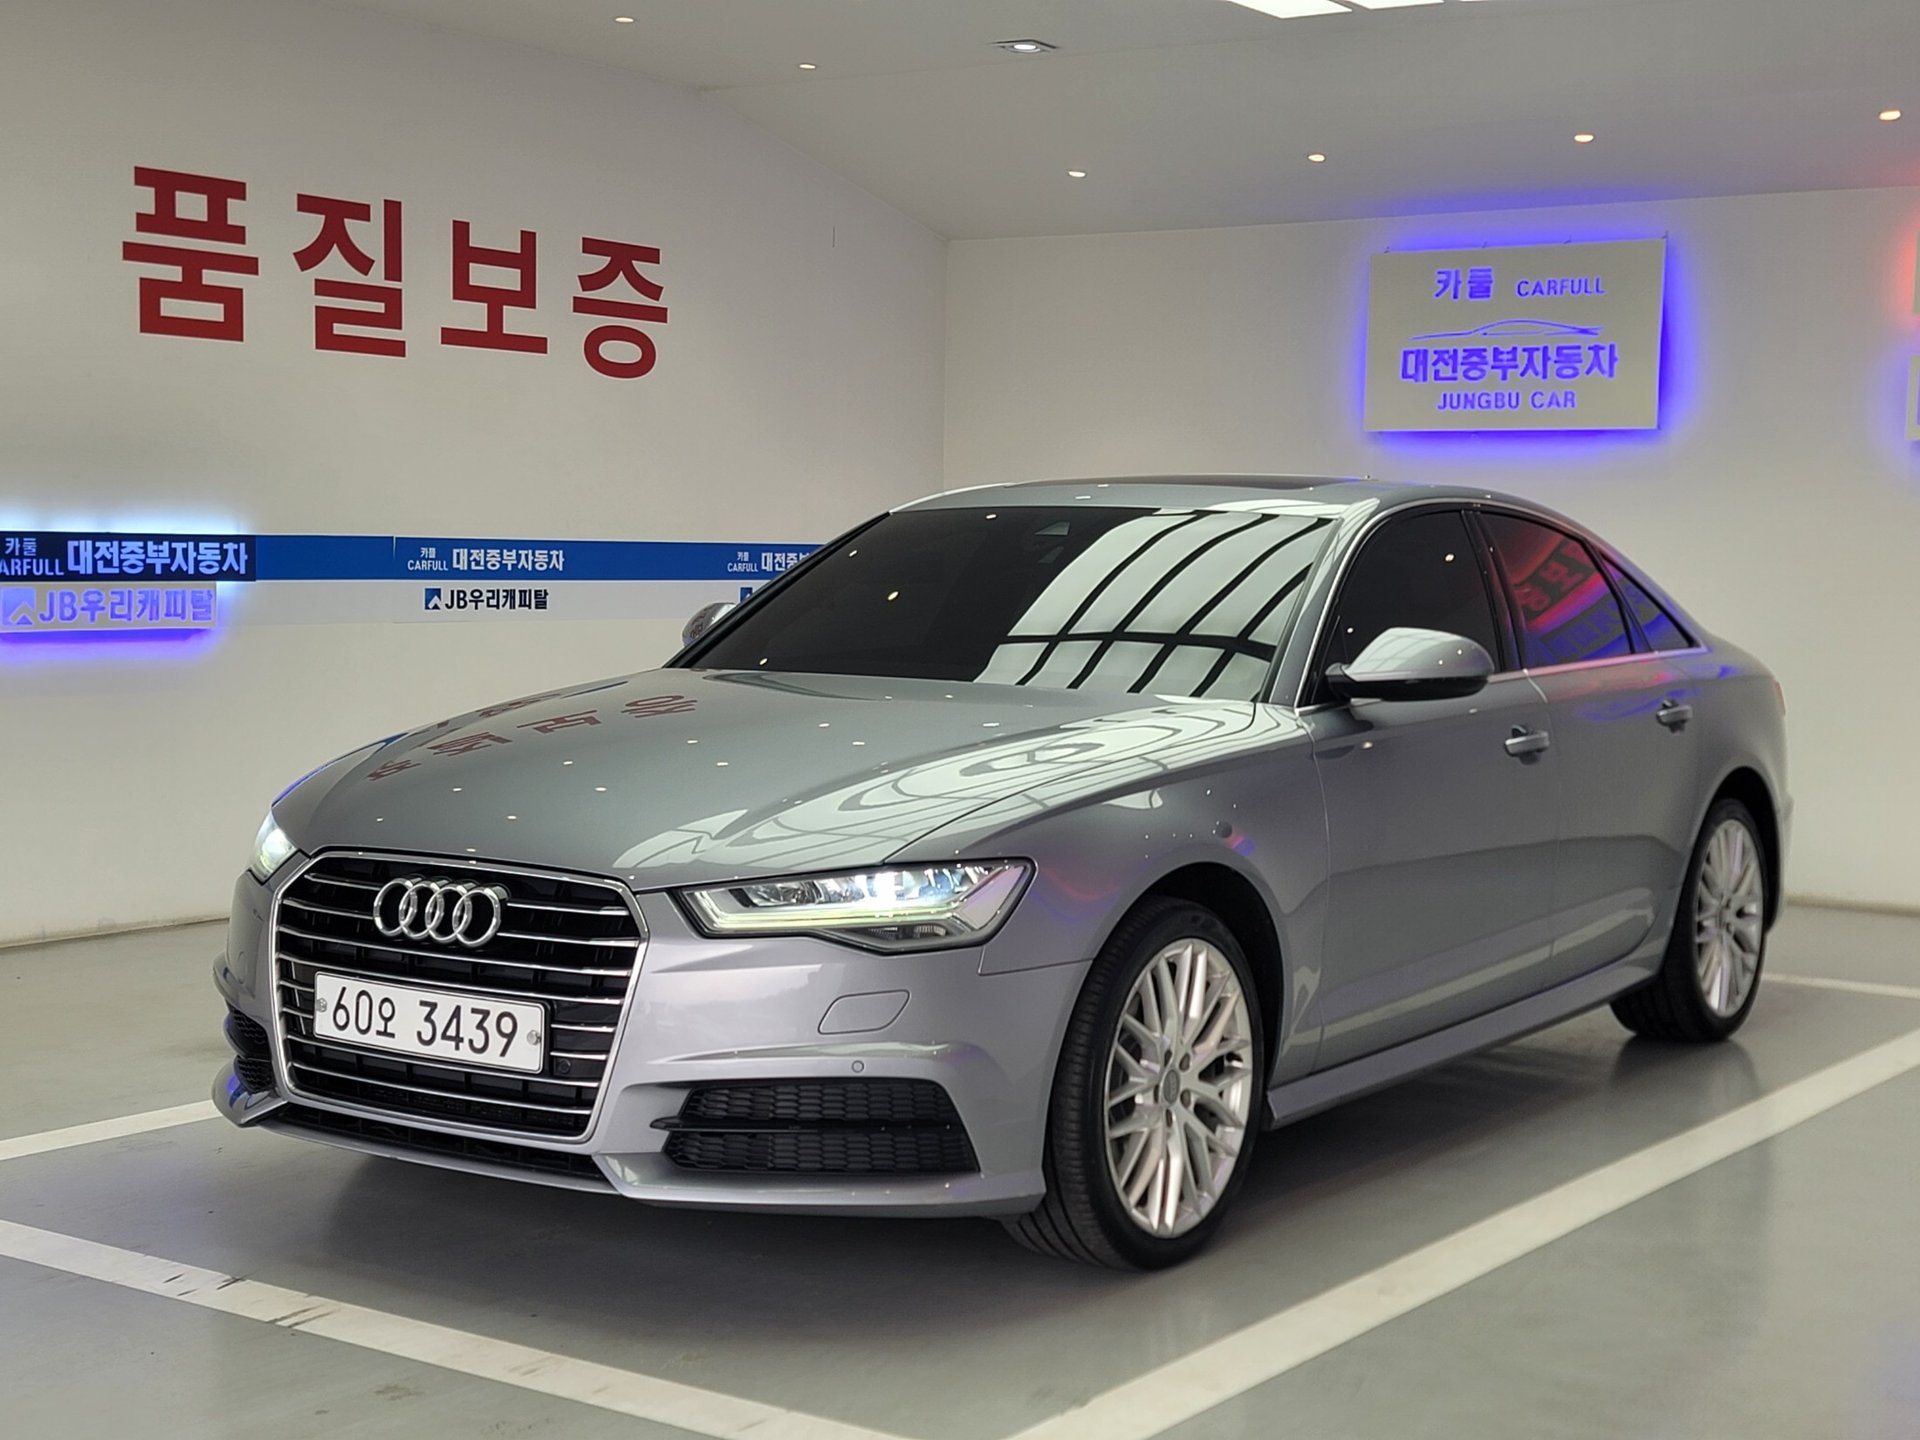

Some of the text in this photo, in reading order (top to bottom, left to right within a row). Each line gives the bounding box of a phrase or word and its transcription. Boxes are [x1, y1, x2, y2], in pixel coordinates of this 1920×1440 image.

[122, 165, 669, 379] 품질보증
[1516, 276, 1607, 298] CARFULL
[1400, 343, 1619, 383] 대전중부자동차
[1436, 390, 1576, 411] JUNGBU CAR
[66, 539, 248, 575] 대전중부자동차
[407, 559, 449, 571] CARFULL
[452, 548, 565, 571] 대전중부자동차
[727, 562, 759, 572] CARFULL
[38, 588, 214, 623] JB우리캐피탈
[445, 588, 549, 611] JB우리캐피탈
[332, 986, 518, 1058] 60오 3439
